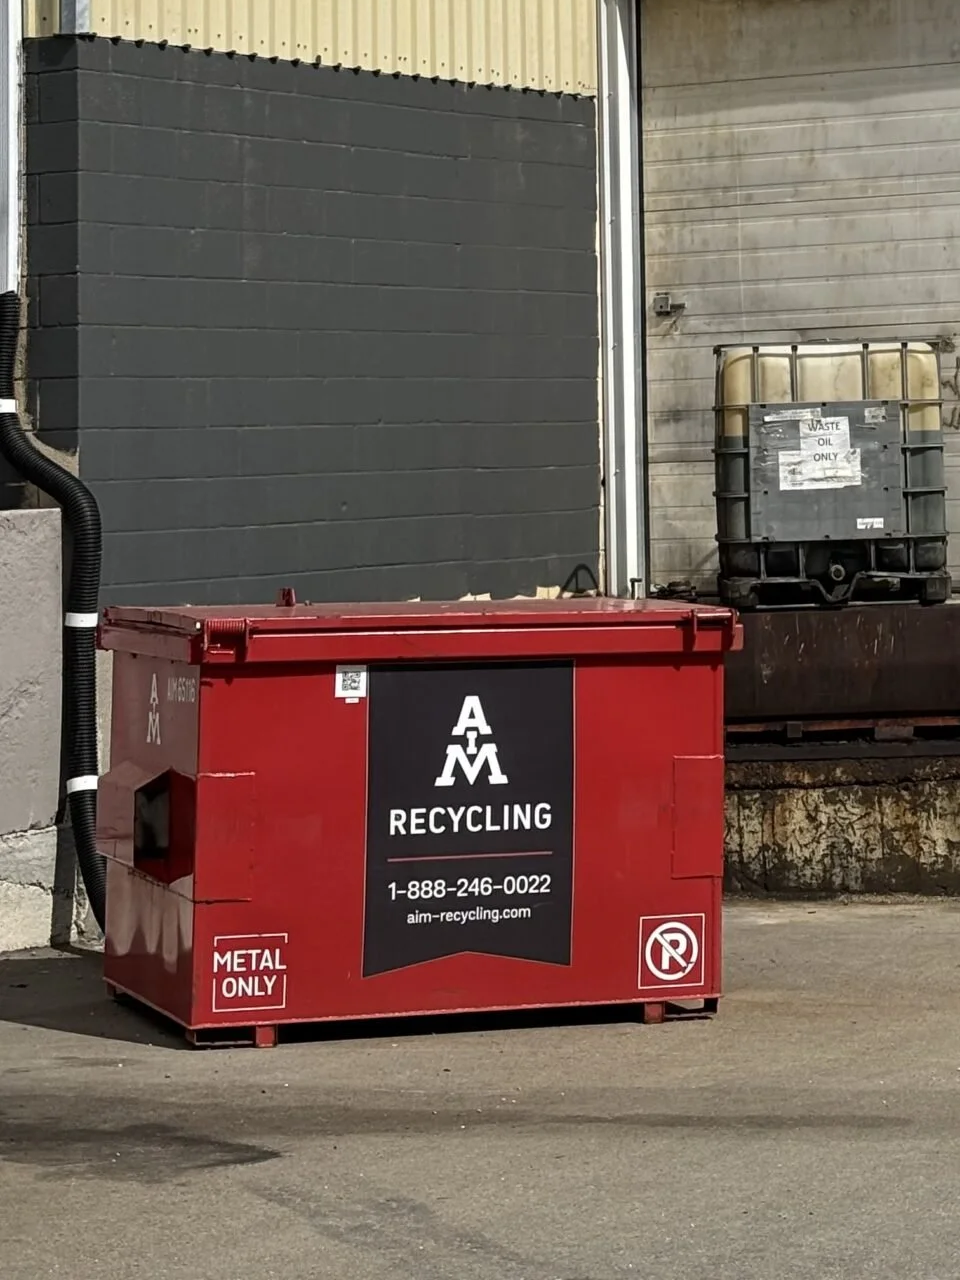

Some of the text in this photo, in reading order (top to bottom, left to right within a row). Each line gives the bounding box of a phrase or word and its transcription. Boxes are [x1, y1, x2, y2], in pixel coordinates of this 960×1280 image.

[807, 421, 841, 432] WASTE
[817, 437, 834, 447] OIL
[812, 452, 839, 462] ONLY
[389, 802, 552, 836] RECYCLING
[387, 874, 552, 901] 1-888-246-0022
[406, 906, 532, 925] aim-recycling.com
[213, 948, 288, 973] METAL
[221, 974, 277, 999] ONLY
